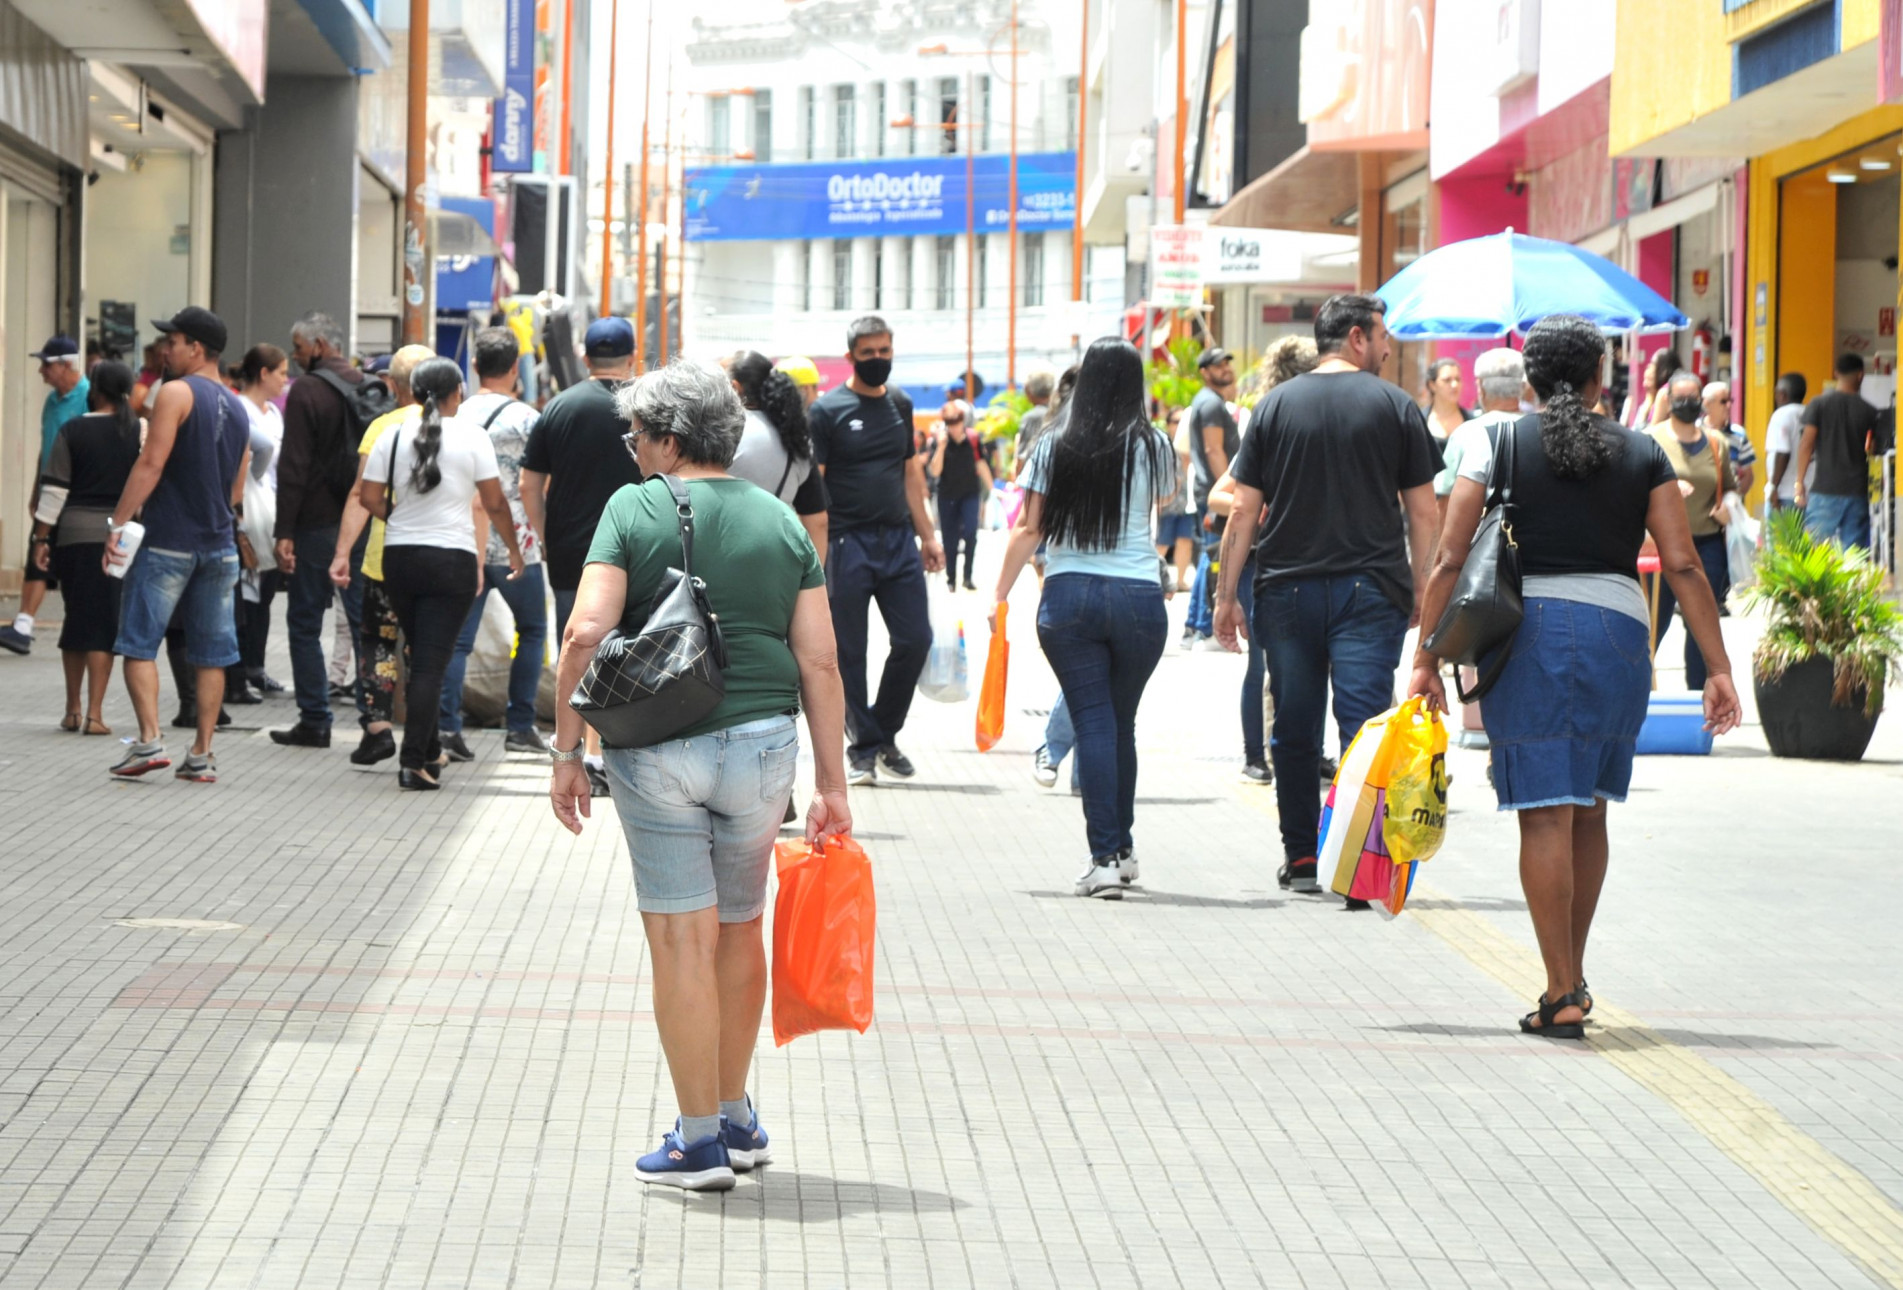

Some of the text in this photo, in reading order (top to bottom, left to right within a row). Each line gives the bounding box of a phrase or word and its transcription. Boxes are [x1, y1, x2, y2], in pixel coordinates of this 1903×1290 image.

[499, 87, 527, 163] danny
[827, 171, 944, 202] OrtoDoctor
[1220, 236, 1260, 259] foka
